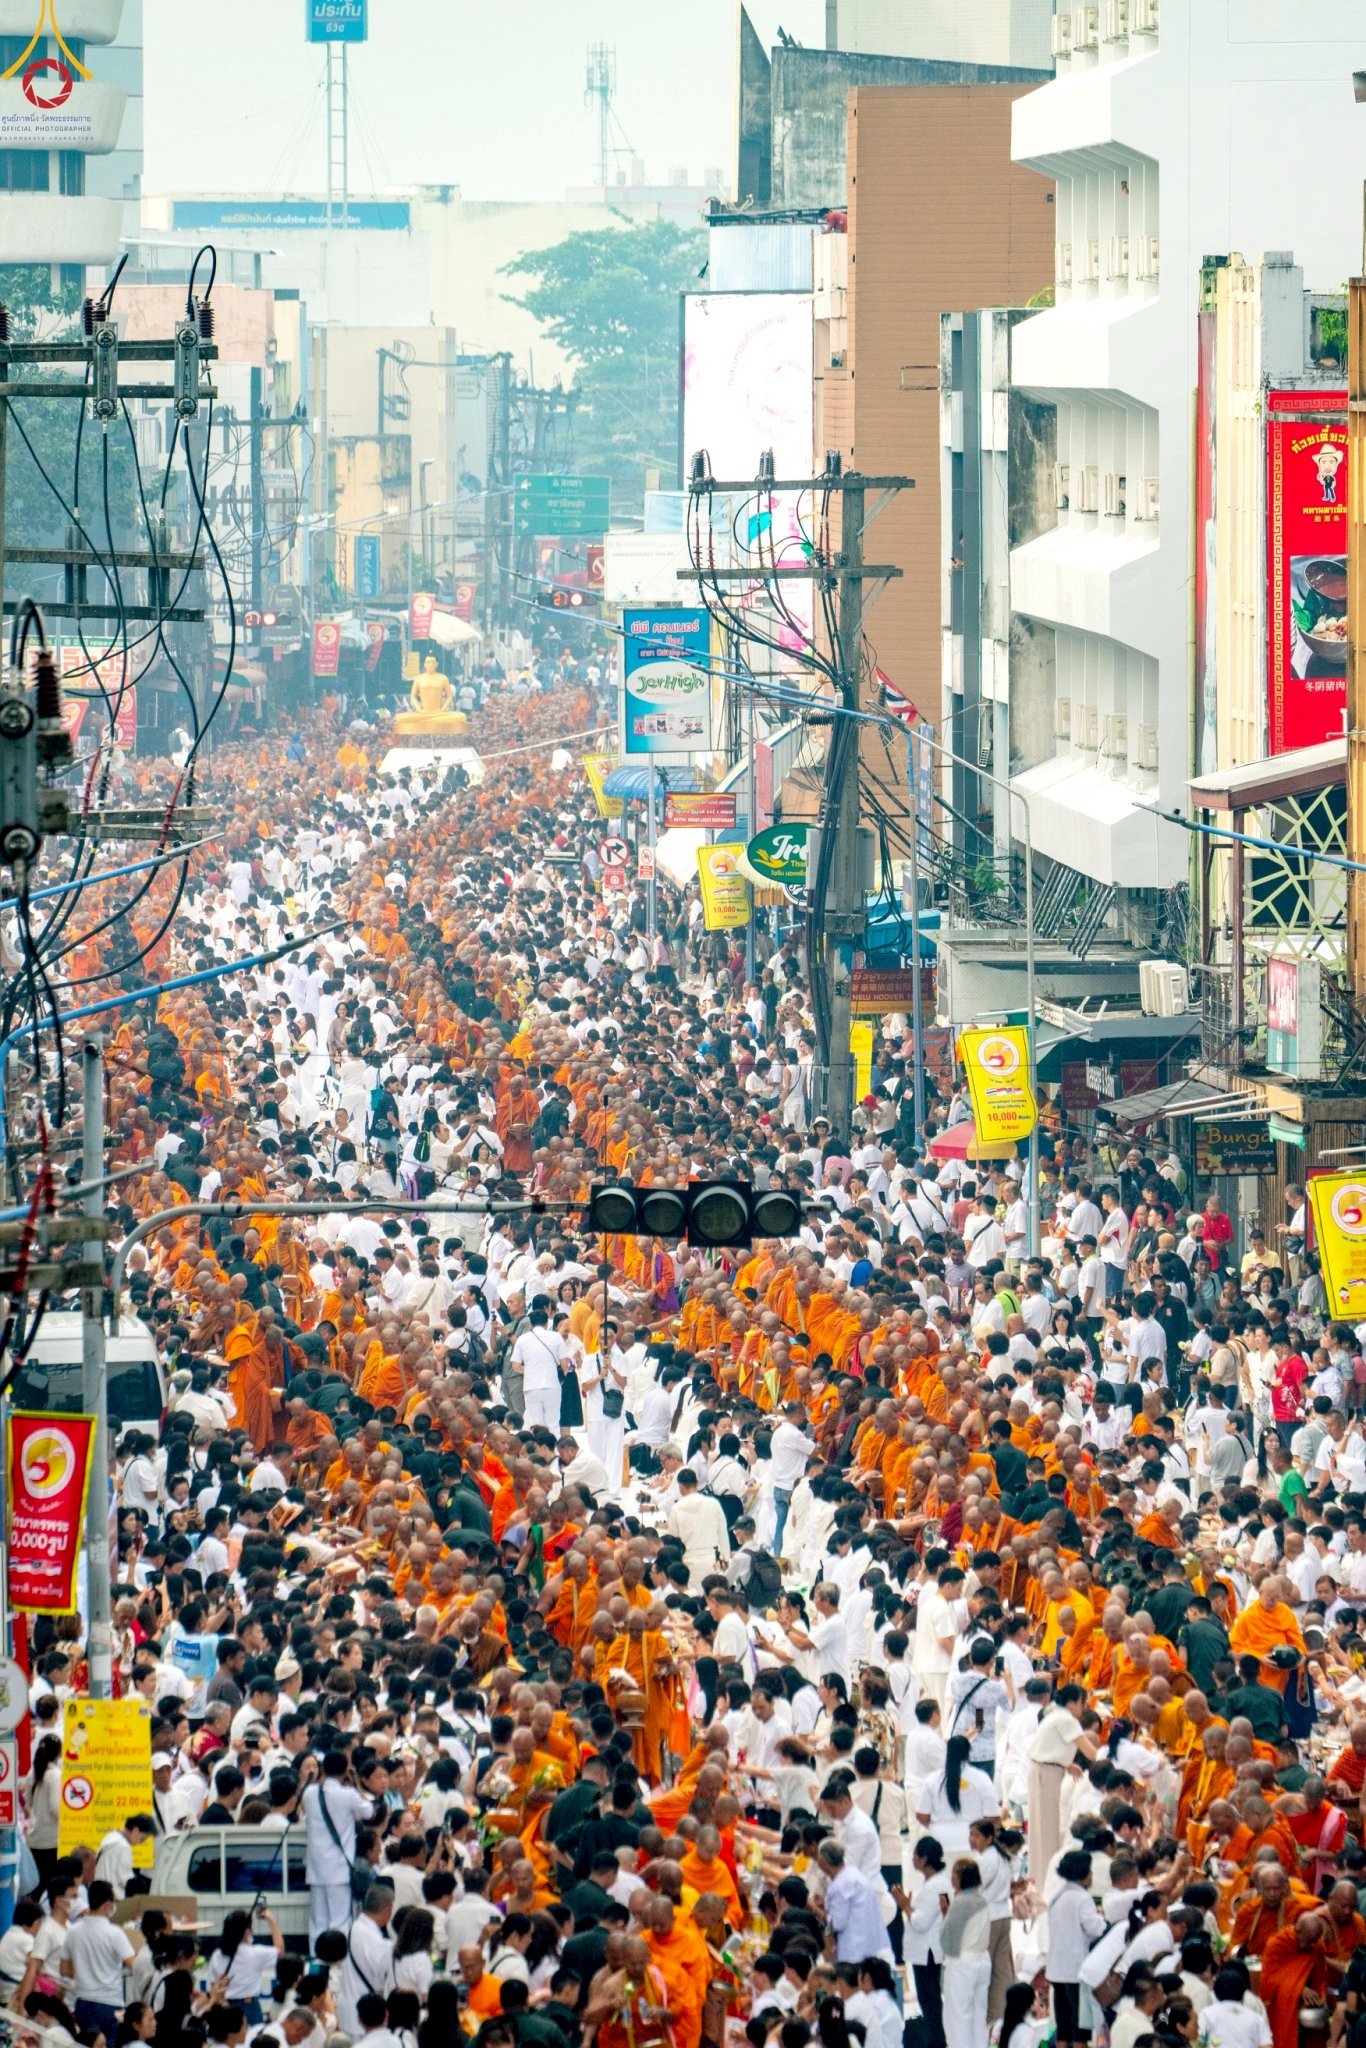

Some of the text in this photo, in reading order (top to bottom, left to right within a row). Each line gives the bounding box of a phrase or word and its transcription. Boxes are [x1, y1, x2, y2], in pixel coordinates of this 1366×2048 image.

[314, 2, 362, 17] ประกัน
[636, 672, 705, 694] JerHigh
[987, 1111, 1017, 1122] 10,000
[1206, 1127, 1270, 1150] Bunga
[1223, 1147, 1275, 1158] Spa & massage
[11, 1530, 68, 1557] 0,000รูป
[116, 1797, 139, 1807] 22.00
